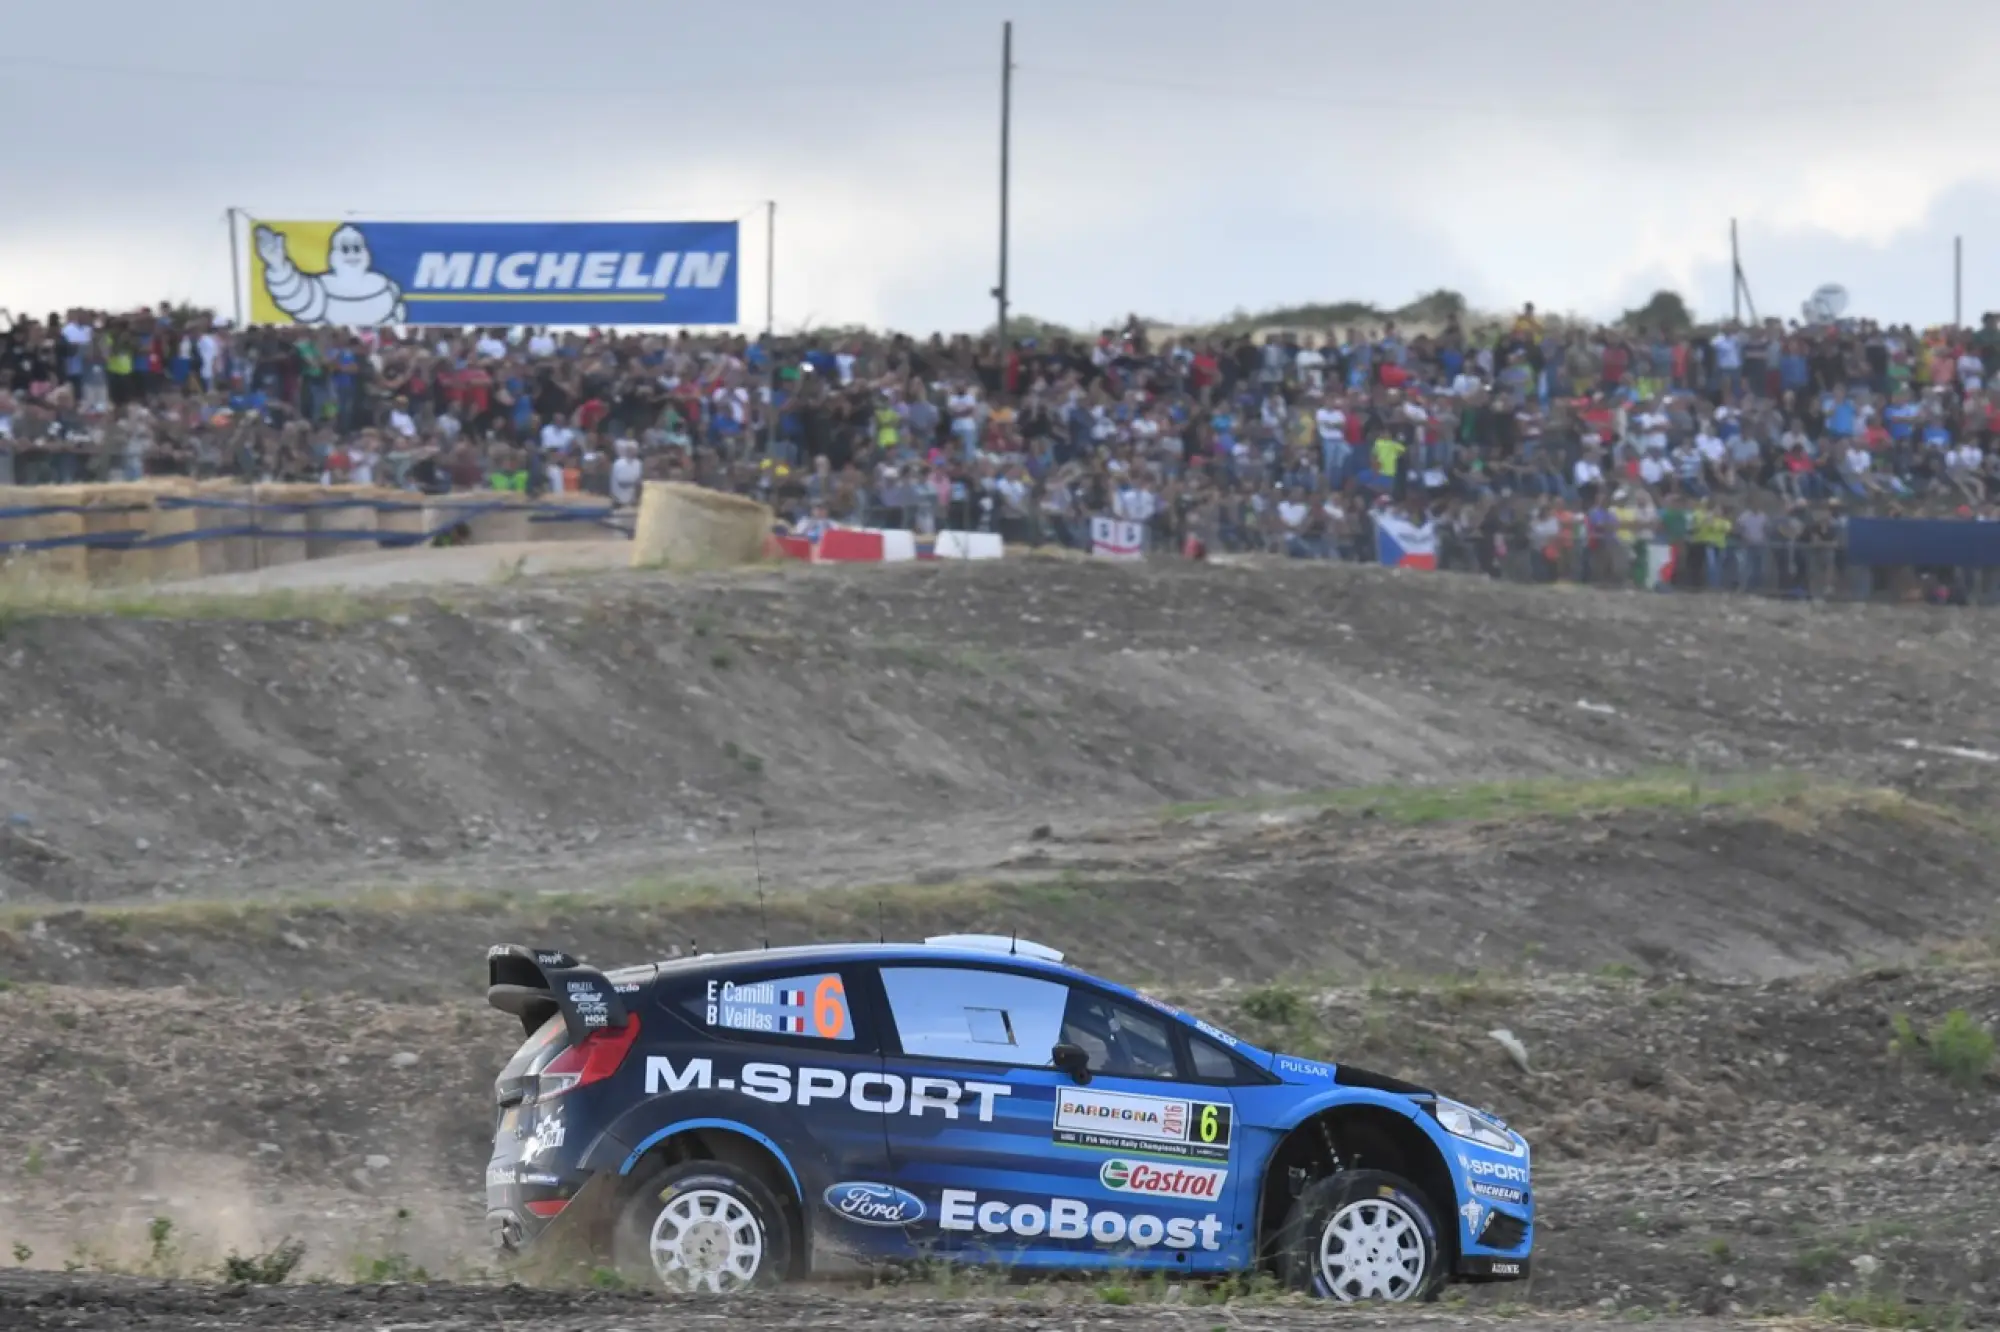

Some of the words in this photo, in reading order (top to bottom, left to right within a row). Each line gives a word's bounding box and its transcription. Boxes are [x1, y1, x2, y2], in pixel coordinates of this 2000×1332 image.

[413, 251, 730, 289] MICHELIN
[707, 979, 719, 1002] E
[724, 980, 775, 1005] Camilli
[813, 976, 844, 1039] 6
[706, 1004, 719, 1026] B
[724, 1006, 773, 1030] Veillas
[1280, 1059, 1329, 1078] PULSAR
[645, 1055, 1011, 1122] M-SPORT
[1063, 1103, 1158, 1123] SARDEGNA
[1200, 1104, 1218, 1143] 6
[1129, 1164, 1218, 1197] Castrol
[1475, 1182, 1520, 1200] MICHELIN
[839, 1186, 903, 1221] Ford
[939, 1188, 1222, 1250] EcoBoost
